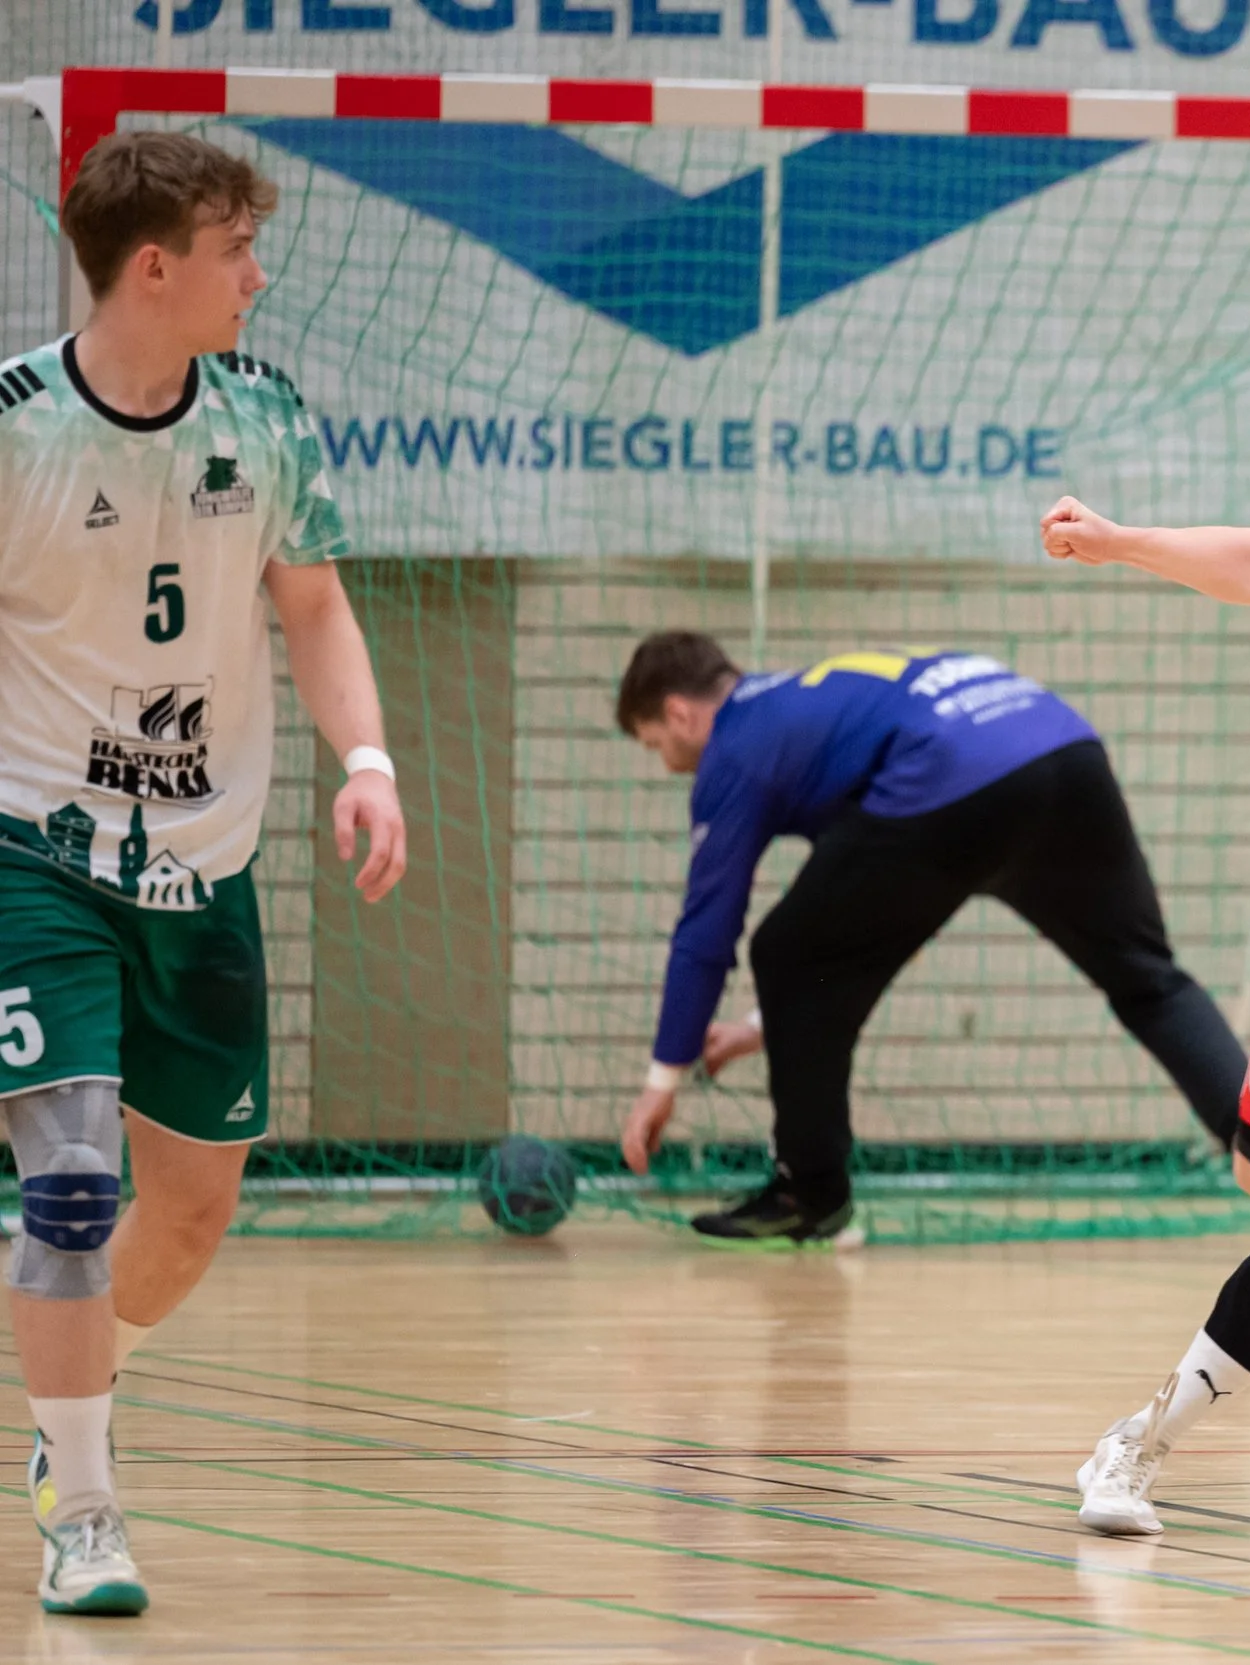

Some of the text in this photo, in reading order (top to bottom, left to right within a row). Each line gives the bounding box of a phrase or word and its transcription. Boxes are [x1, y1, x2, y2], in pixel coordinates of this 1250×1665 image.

[320, 416, 1062, 478] WWW.SIEGLER-BAU.DE
[84, 514, 120, 529] SELECT
[144, 563, 186, 644] 5
[0, 985, 45, 1067] 5
